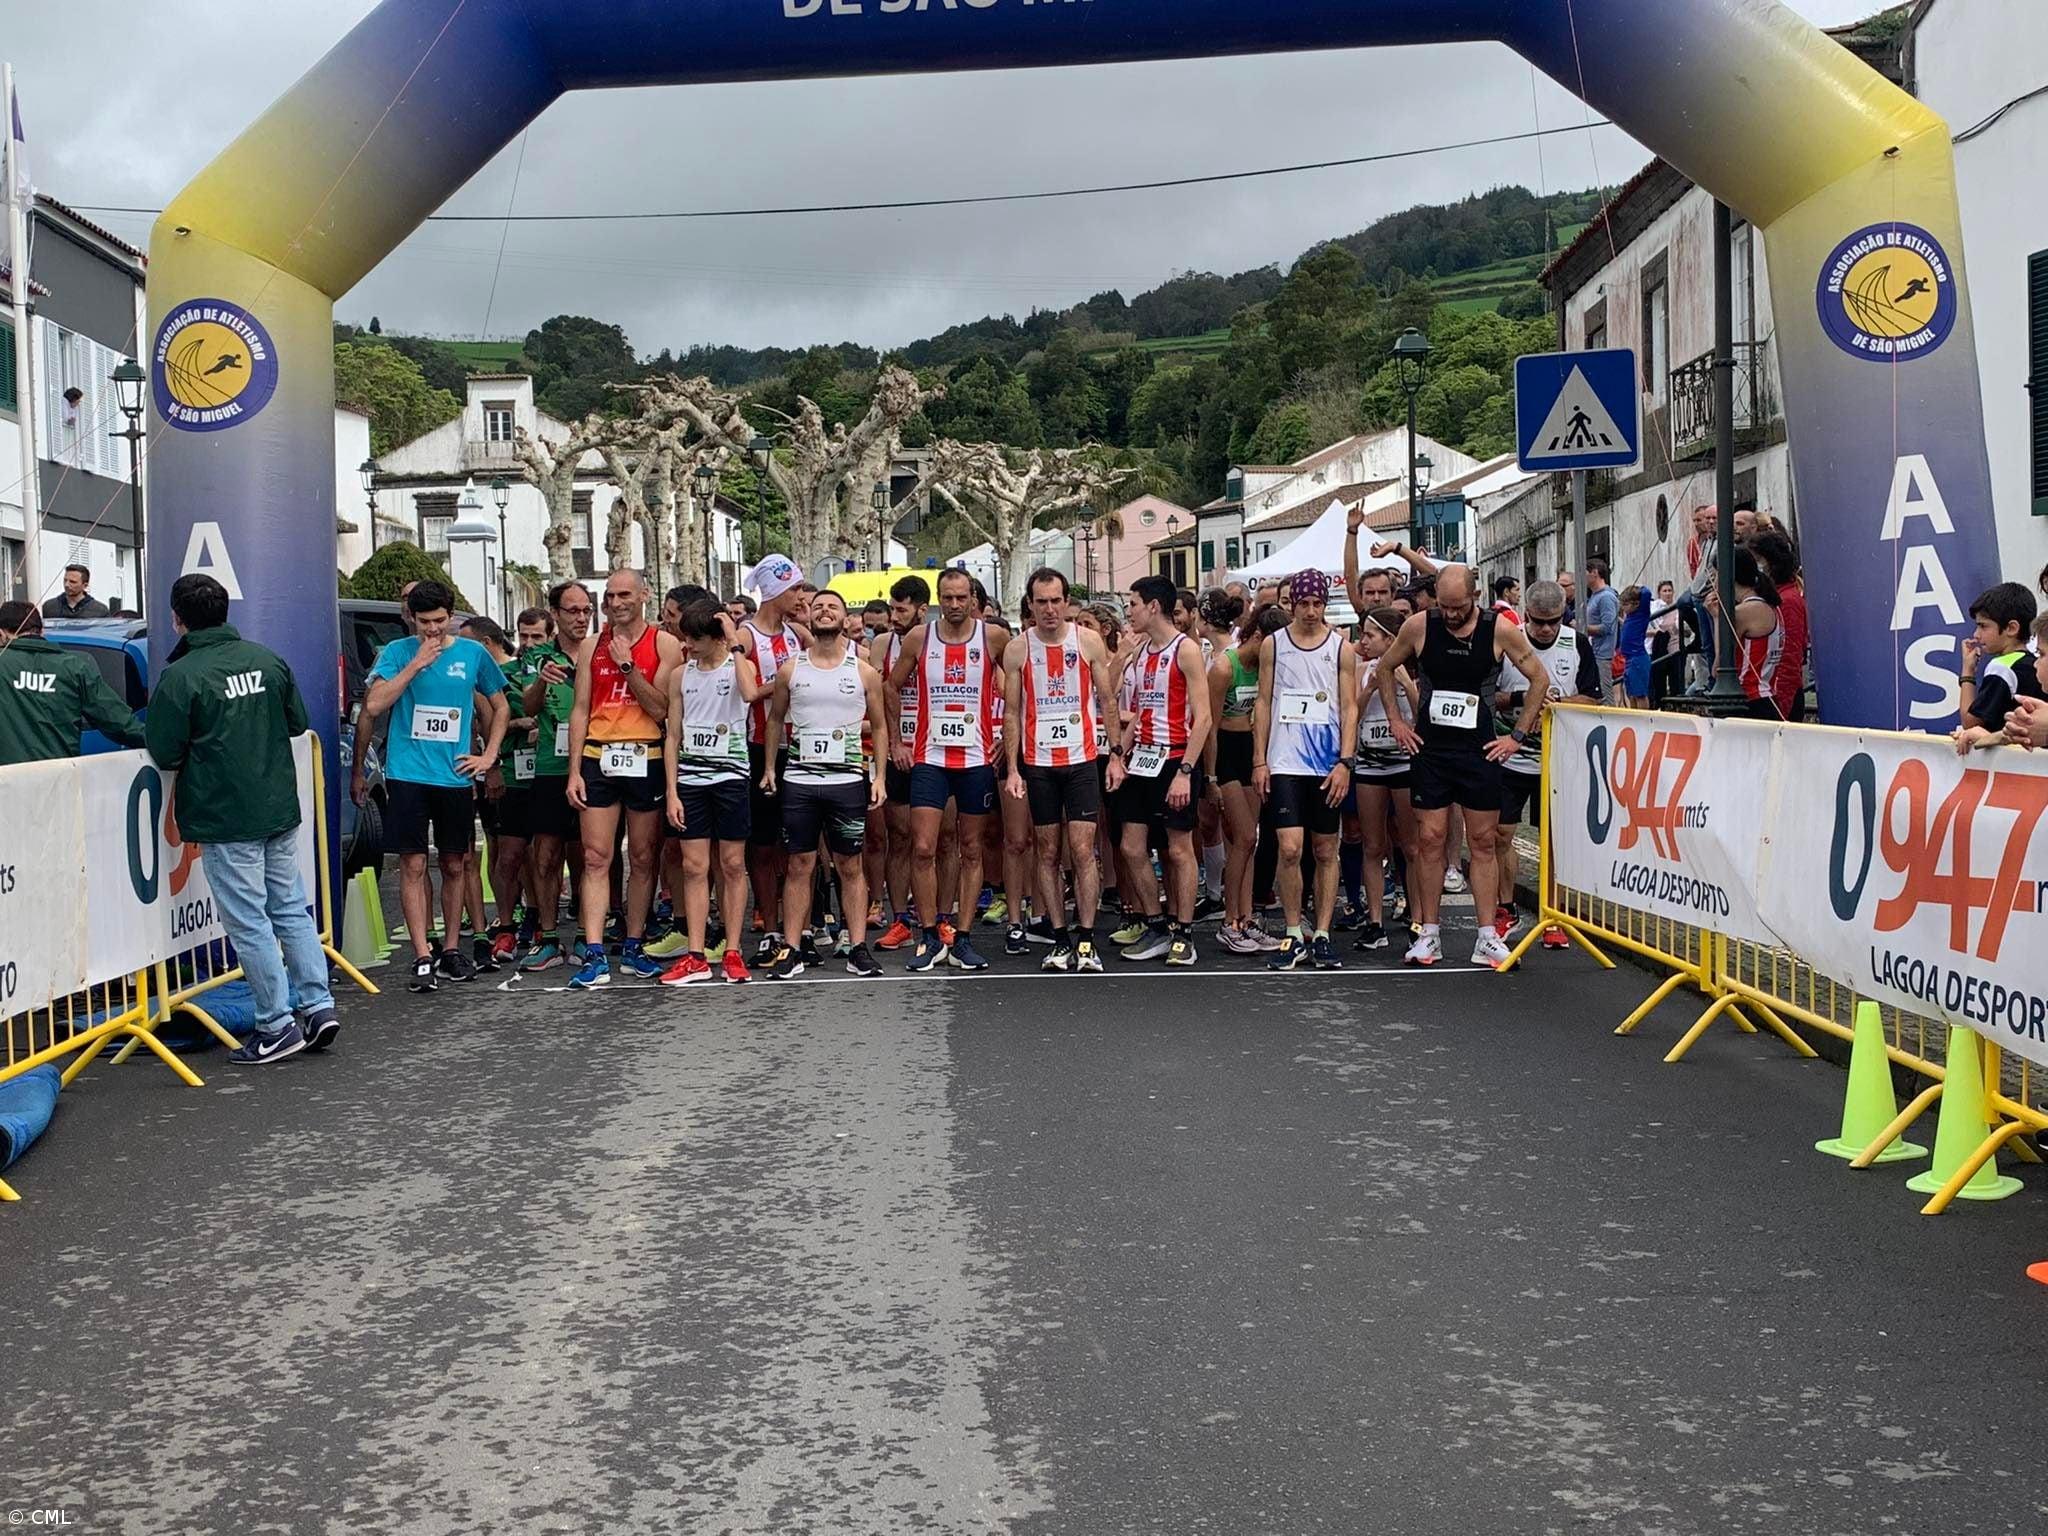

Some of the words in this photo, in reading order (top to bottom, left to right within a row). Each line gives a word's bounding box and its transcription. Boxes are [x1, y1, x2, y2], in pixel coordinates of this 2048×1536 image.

[1828, 234, 1884, 293] ASSOCIAÇÃO
[1887, 232, 1902, 245] DE
[1903, 235, 1947, 283] ATLETISMO
[157, 308, 201, 362] ASSOCIAÇÃO
[203, 308, 217, 321] DE
[219, 310, 266, 360] ATLETISMO
[1852, 332, 1870, 348] DE
[1869, 338, 1893, 353] SÃO
[1895, 328, 1936, 353] MIGUEL
[167, 402, 181, 417] DE
[179, 409, 198, 423] SÃO
[201, 402, 243, 423] MIGUEL
[13, 671, 56, 693] JUIZ
[224, 670, 266, 699] JUIZ
[930, 686, 979, 695] STELAÇOR
[1036, 695, 1080, 706] STELAÇOR
[1301, 702, 1308, 714] 7
[1442, 703, 1465, 717] 687
[426, 719, 448, 732] 130
[902, 721, 915, 733] 69
[941, 724, 964, 736] 645
[1051, 725, 1067, 738] 25
[692, 733, 718, 747] 1027
[814, 741, 828, 753] 57
[611, 755, 633, 767] 675
[1136, 756, 1159, 769] 1009
[1611, 860, 1658, 897] LAGOA
[1659, 871, 1730, 916] DESPORTO
[170, 897, 212, 939] LAGOA
[1871, 946, 1940, 1005] LAGOA
[1946, 970, 2048, 1043] DESPOR
